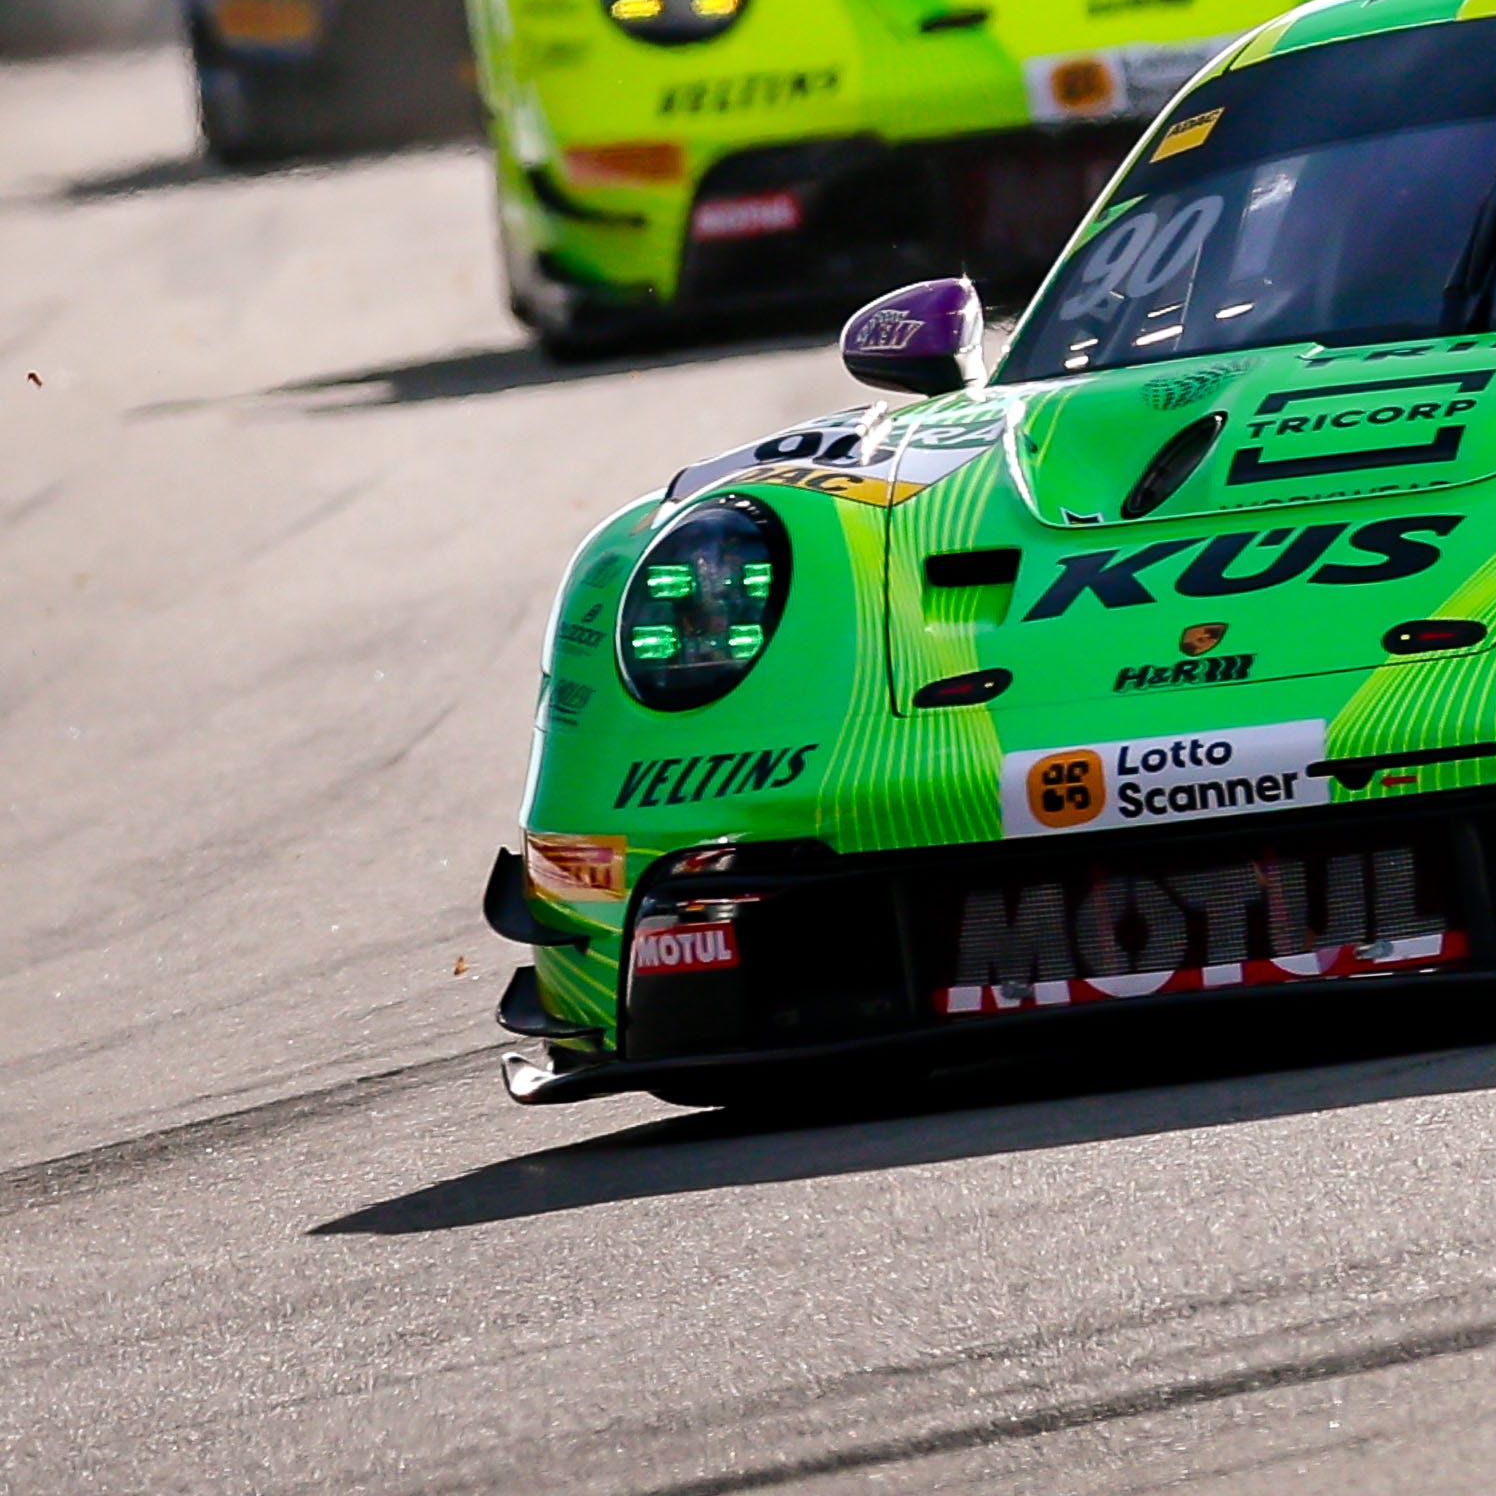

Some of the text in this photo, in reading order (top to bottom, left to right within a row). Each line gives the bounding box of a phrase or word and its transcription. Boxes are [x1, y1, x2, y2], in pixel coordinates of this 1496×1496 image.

[1059, 194, 1235, 321] 90
[1249, 396, 1477, 440] TRICORP
[613, 744, 819, 810] VELTINS
[1117, 738, 1233, 776] Lotto
[1117, 771, 1299, 819] Scanner
[636, 930, 733, 968] MOTUL
[948, 847, 1447, 1014] MOTUL
